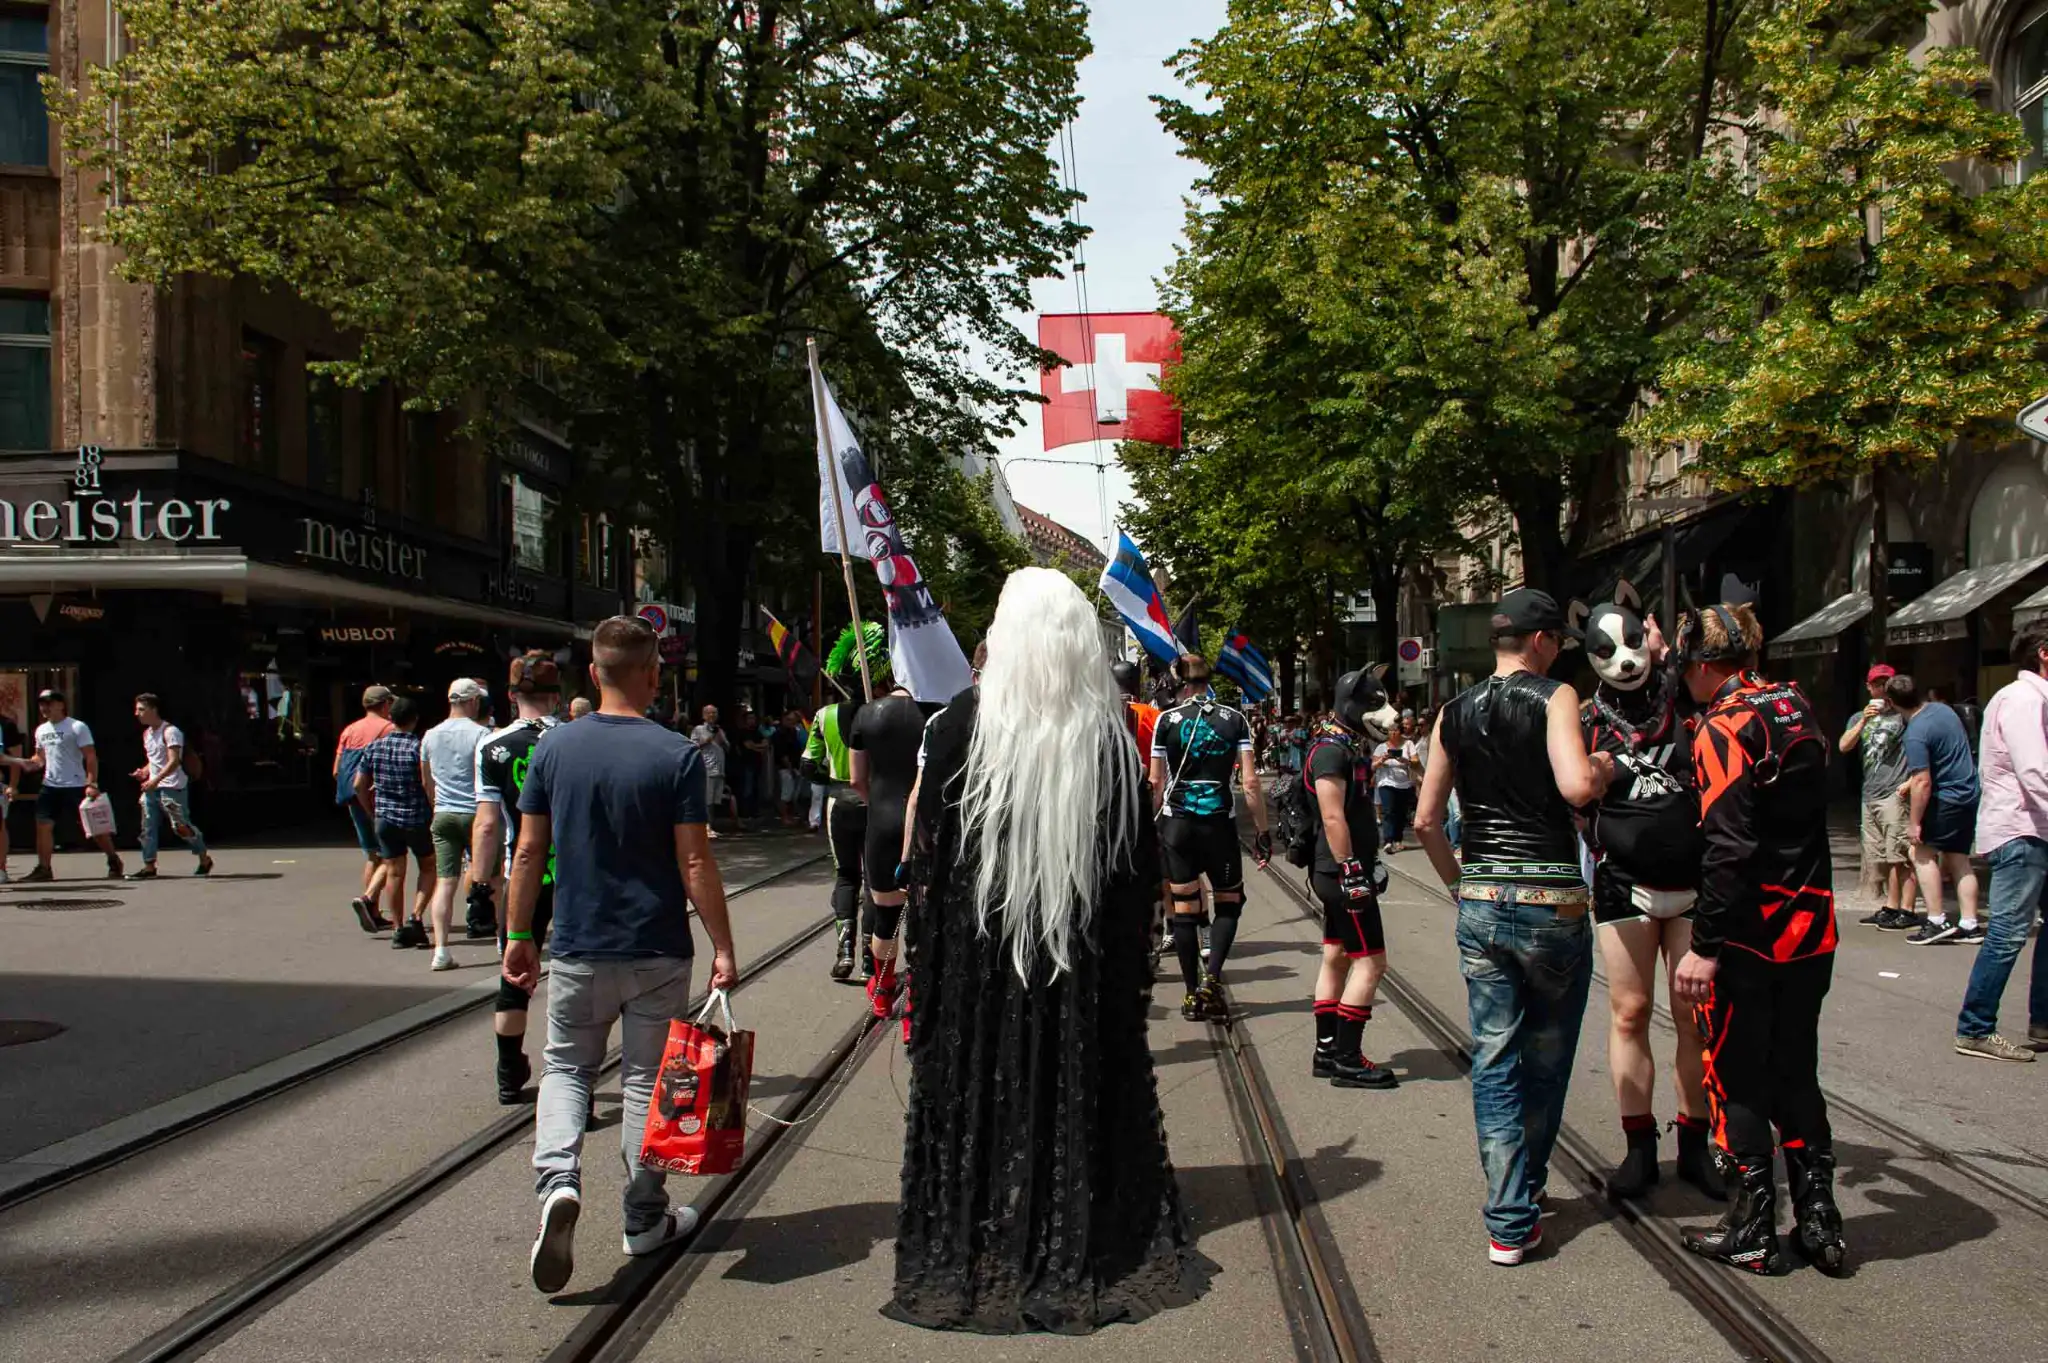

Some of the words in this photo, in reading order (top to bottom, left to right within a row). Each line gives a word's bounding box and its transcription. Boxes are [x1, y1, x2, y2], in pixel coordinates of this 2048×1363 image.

[76, 445, 103, 465] 18
[74, 467, 102, 488] 81
[296, 518, 428, 580] meister
[321, 627, 398, 642] HUBLOT
